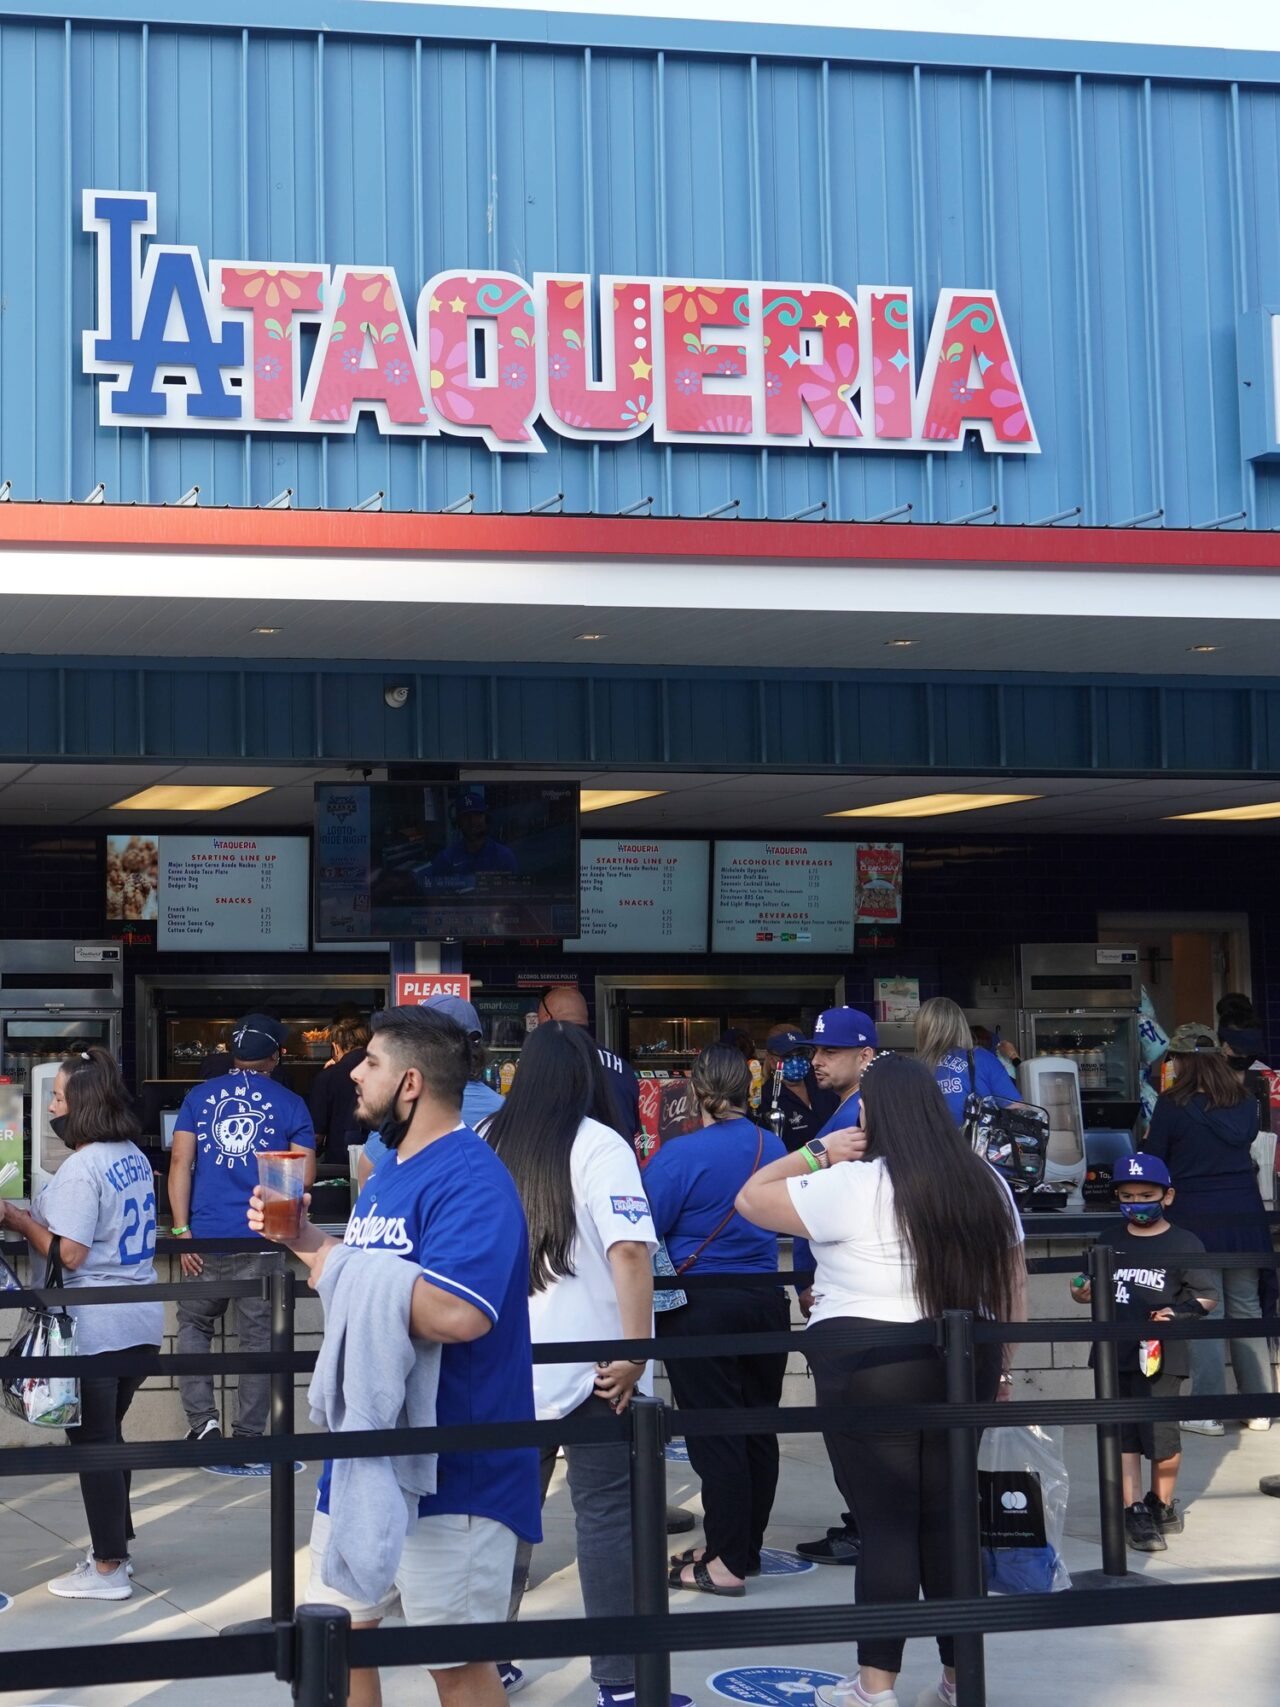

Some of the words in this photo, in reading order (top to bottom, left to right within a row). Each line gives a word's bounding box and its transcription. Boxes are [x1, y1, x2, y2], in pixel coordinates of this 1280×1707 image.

[93, 197, 246, 418] LA
[220, 267, 1034, 444] TAQUERIA
[404, 983, 460, 996] PLEASE
[597, 1049, 623, 1074] ITH
[939, 1077, 963, 1094] RS
[206, 1086, 273, 1111] VAMOS
[197, 1121, 212, 1153] LOS
[105, 1154, 153, 1193] KERSHA
[1128, 1159, 1144, 1176] LA
[118, 1191, 156, 1266] 22
[343, 1203, 414, 1255] odgers
[1115, 1281, 1130, 1304] LA
